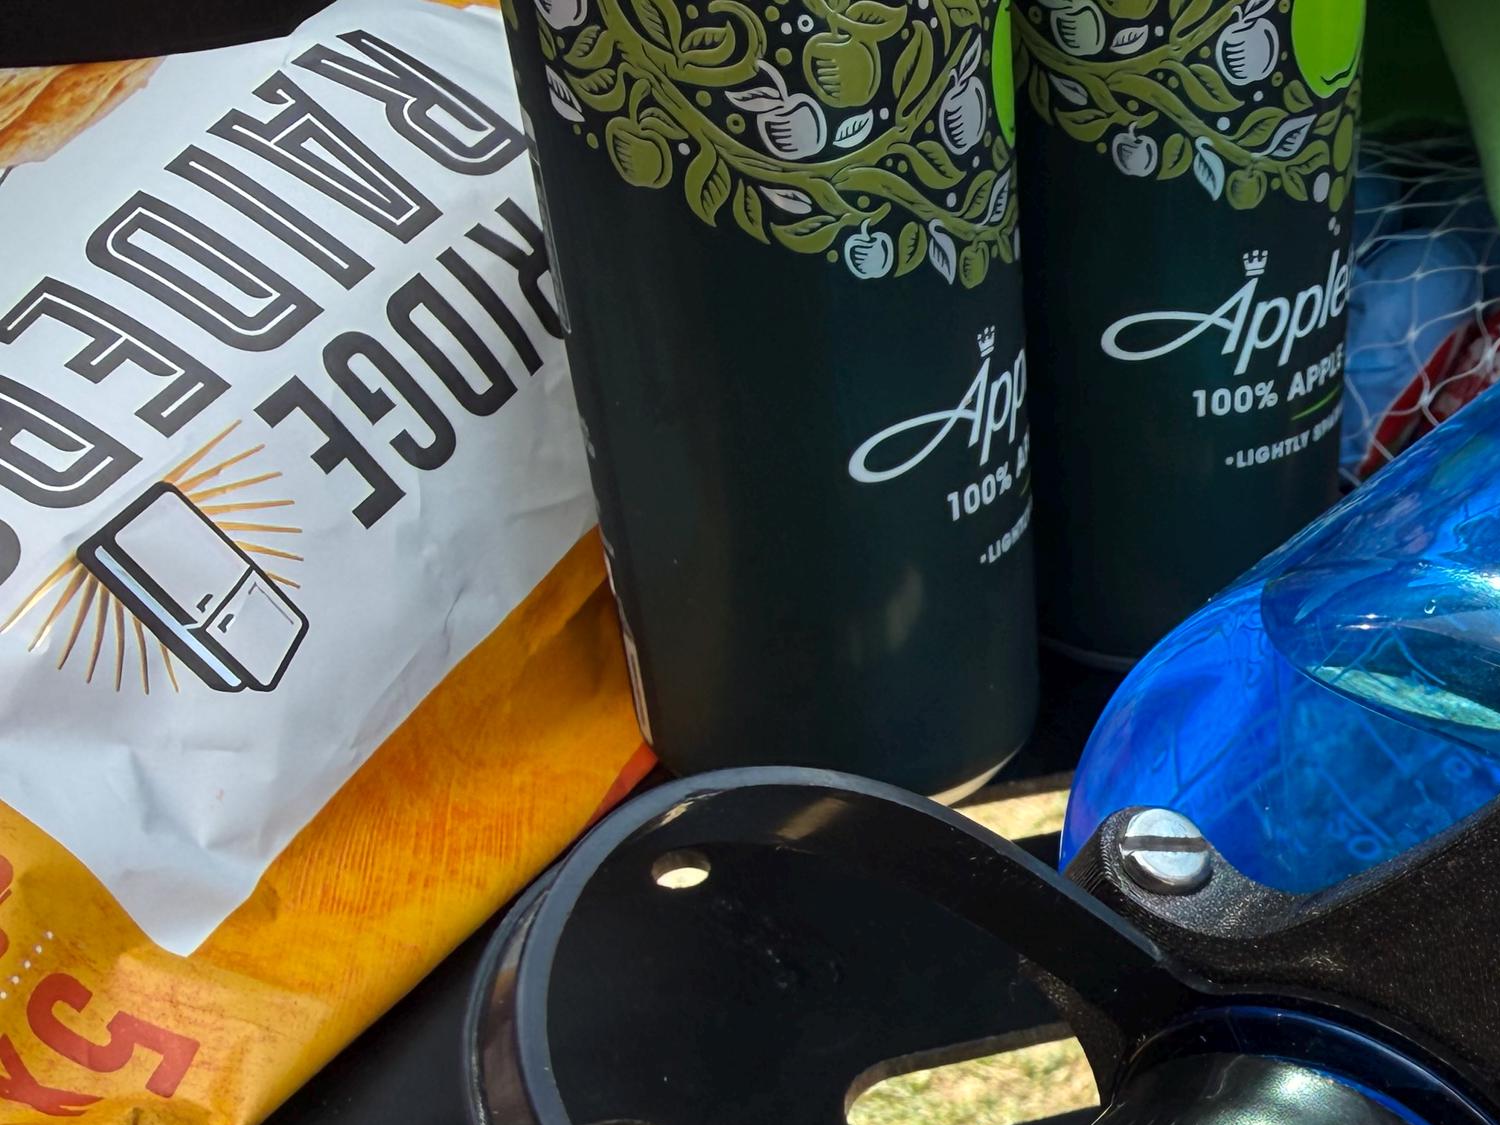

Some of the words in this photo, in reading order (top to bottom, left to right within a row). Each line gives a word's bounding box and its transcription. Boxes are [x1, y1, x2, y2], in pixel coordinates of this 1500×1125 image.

[1101, 249, 1350, 376] Apple
[253, 197, 571, 530] RIDGE
[1192, 380, 1279, 418] 100%
[947, 461, 1012, 522] 100%
